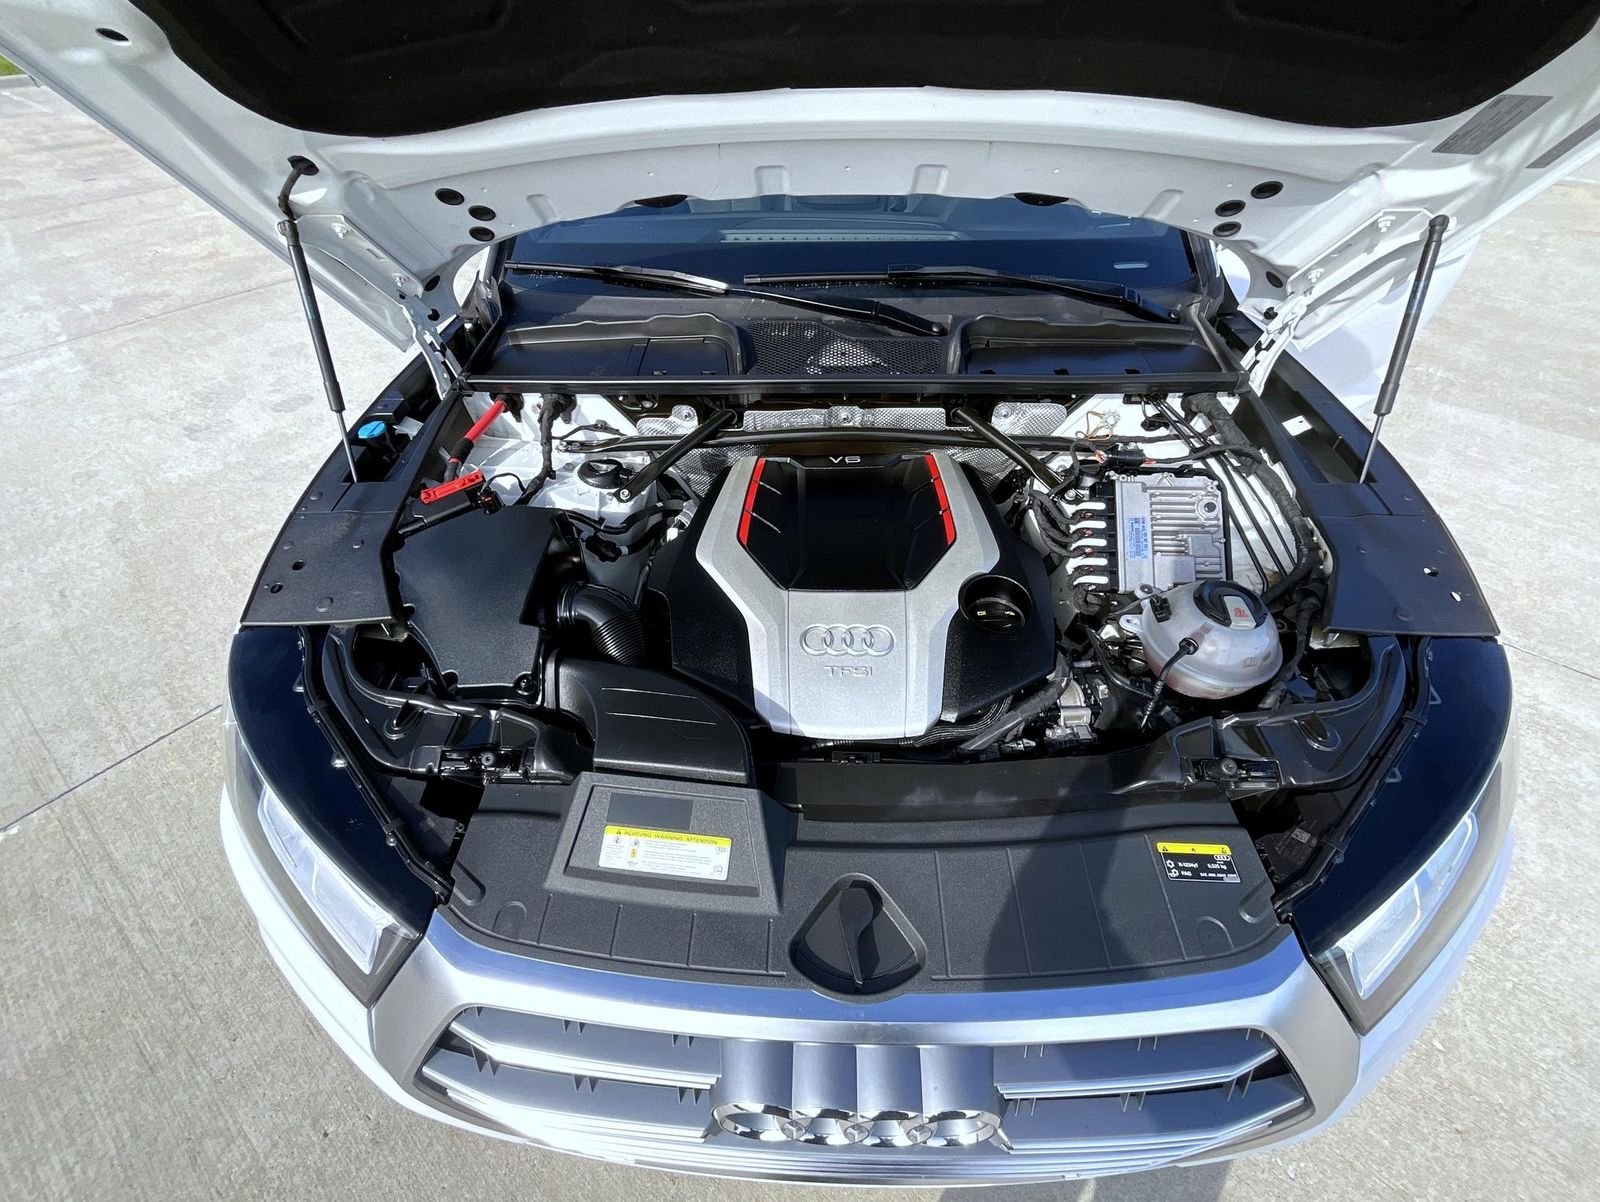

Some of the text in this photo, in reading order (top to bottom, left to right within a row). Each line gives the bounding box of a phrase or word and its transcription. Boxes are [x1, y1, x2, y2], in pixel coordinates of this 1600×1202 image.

[829, 456, 861, 464] V6
[824, 665, 873, 677] TFSI
[623, 831, 718, 845] ACHTUNG WARNING ATTENTION
